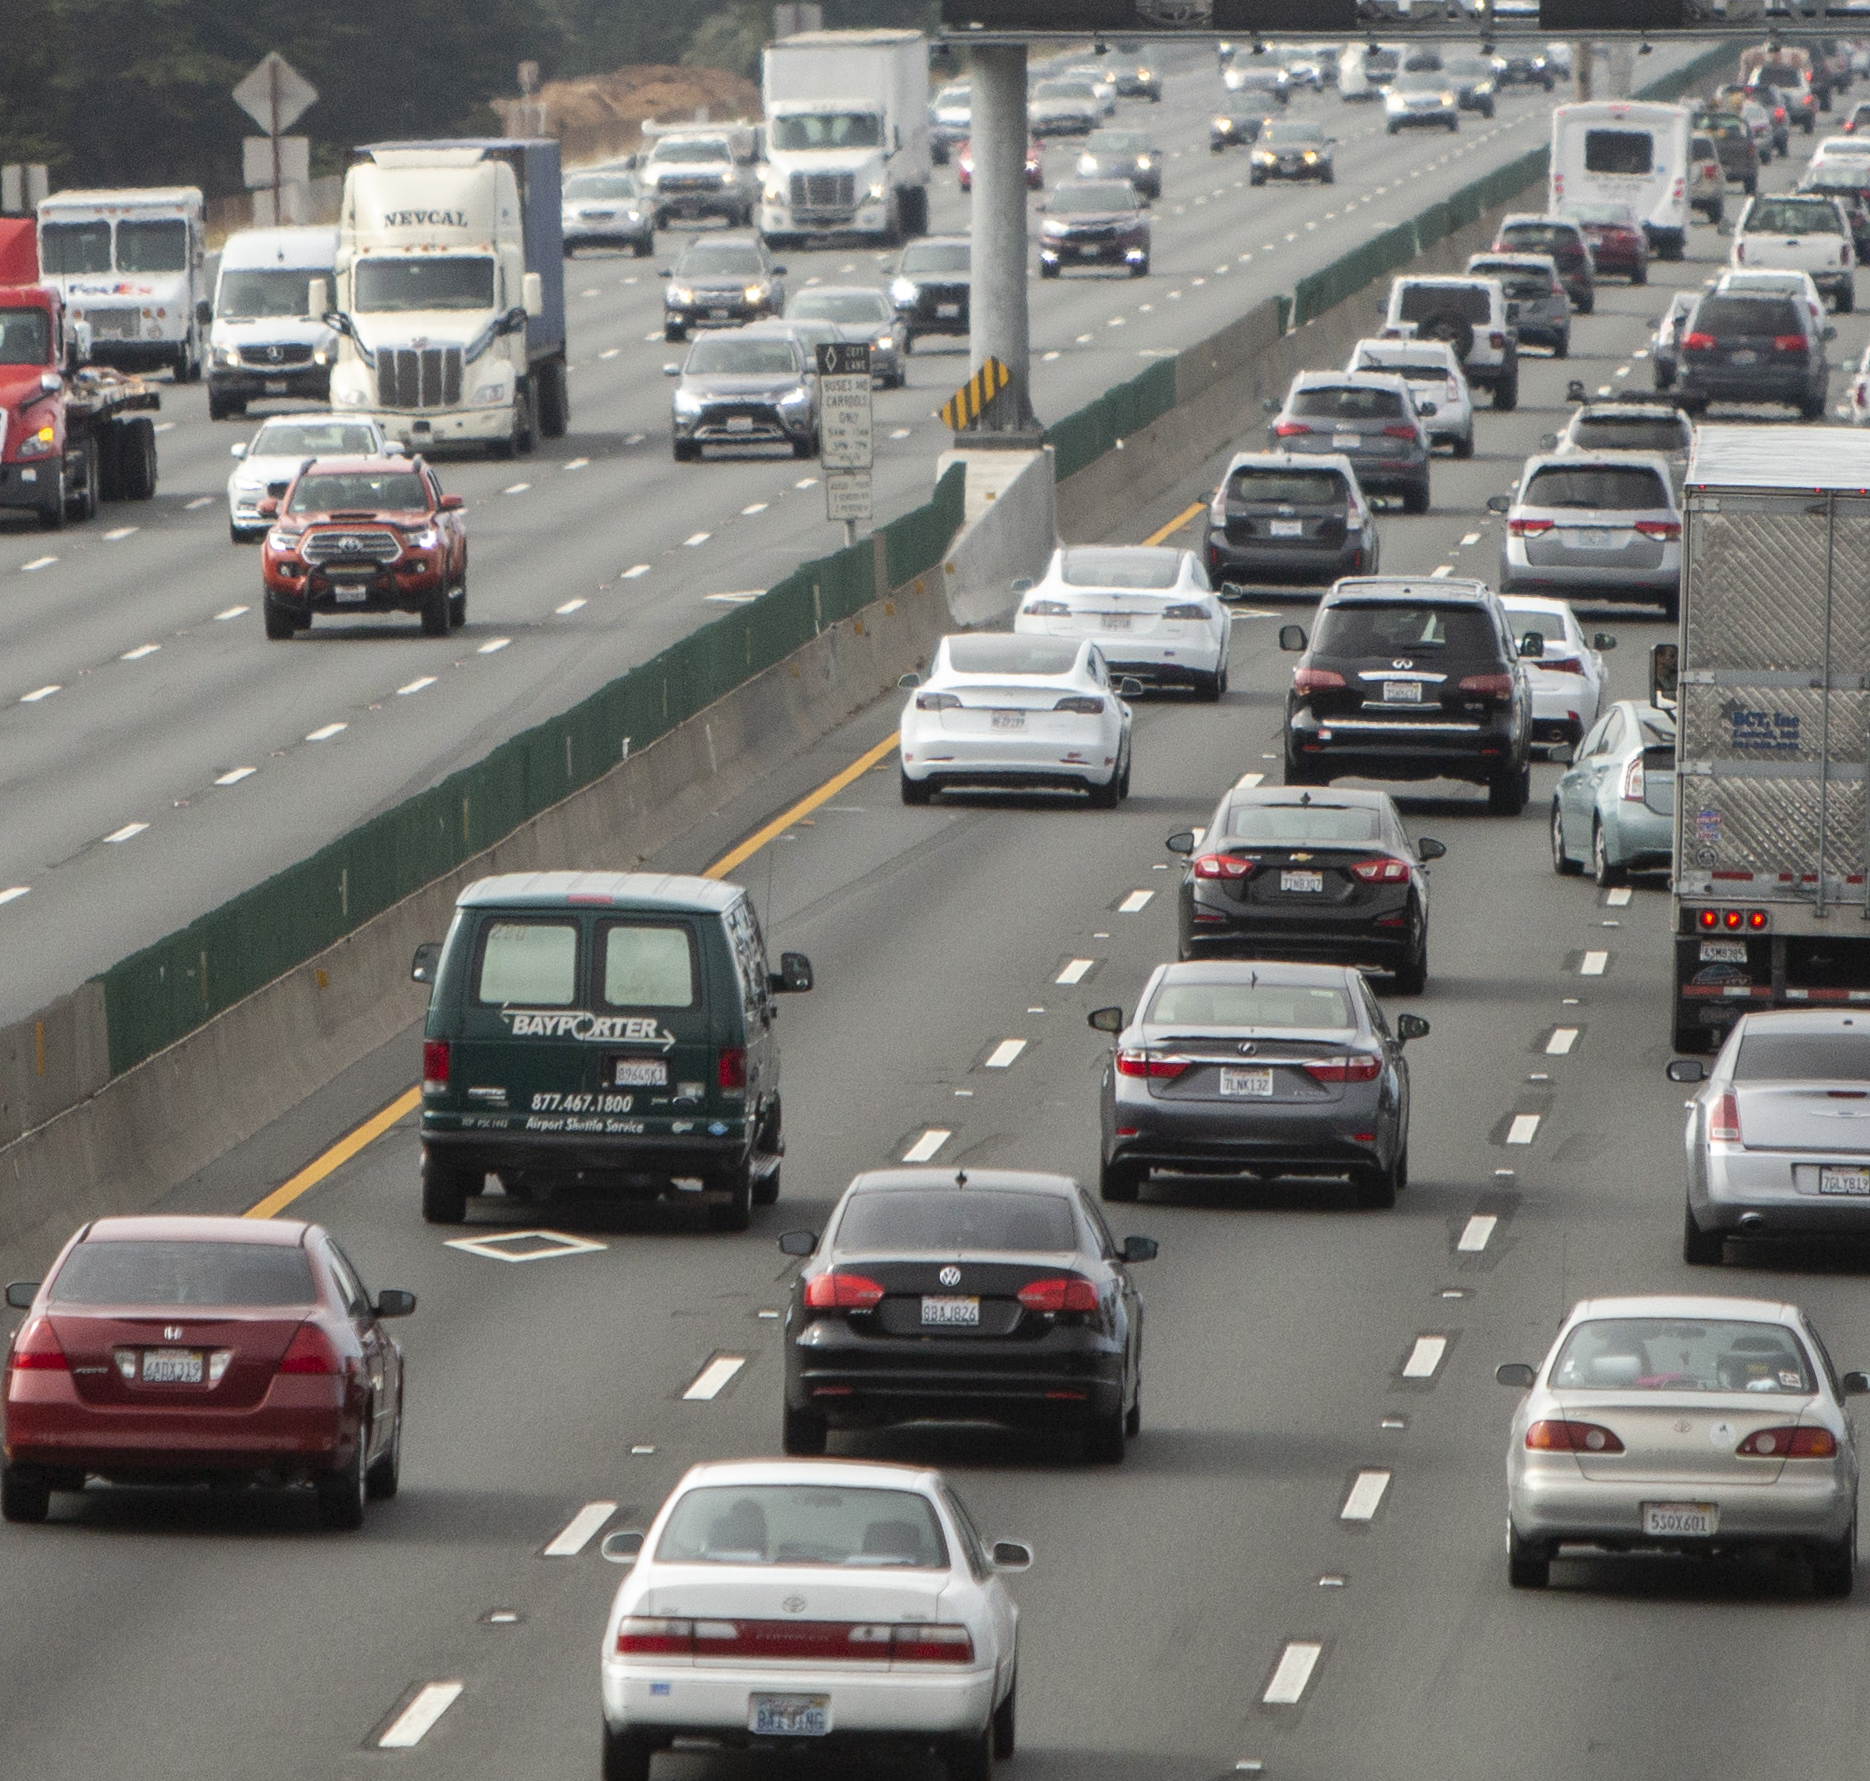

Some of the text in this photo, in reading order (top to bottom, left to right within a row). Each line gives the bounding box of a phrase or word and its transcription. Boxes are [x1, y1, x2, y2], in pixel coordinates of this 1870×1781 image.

[384, 209, 468, 228] NEVCAL
[824, 379, 852, 391] BUSES
[826, 395, 867, 407] CARPOOLS
[1774, 711, 1800, 727] Inc
[512, 1013, 657, 1040] BAYPORTER
[1225, 1078, 1268, 1092] 7LNK132
[531, 1093, 633, 1113] 877.467.1800
[526, 1116, 645, 1133] Airport Shuttle Service
[923, 1305, 977, 1322] 8BAJ826
[1651, 1514, 1707, 1531] 5SQX601
